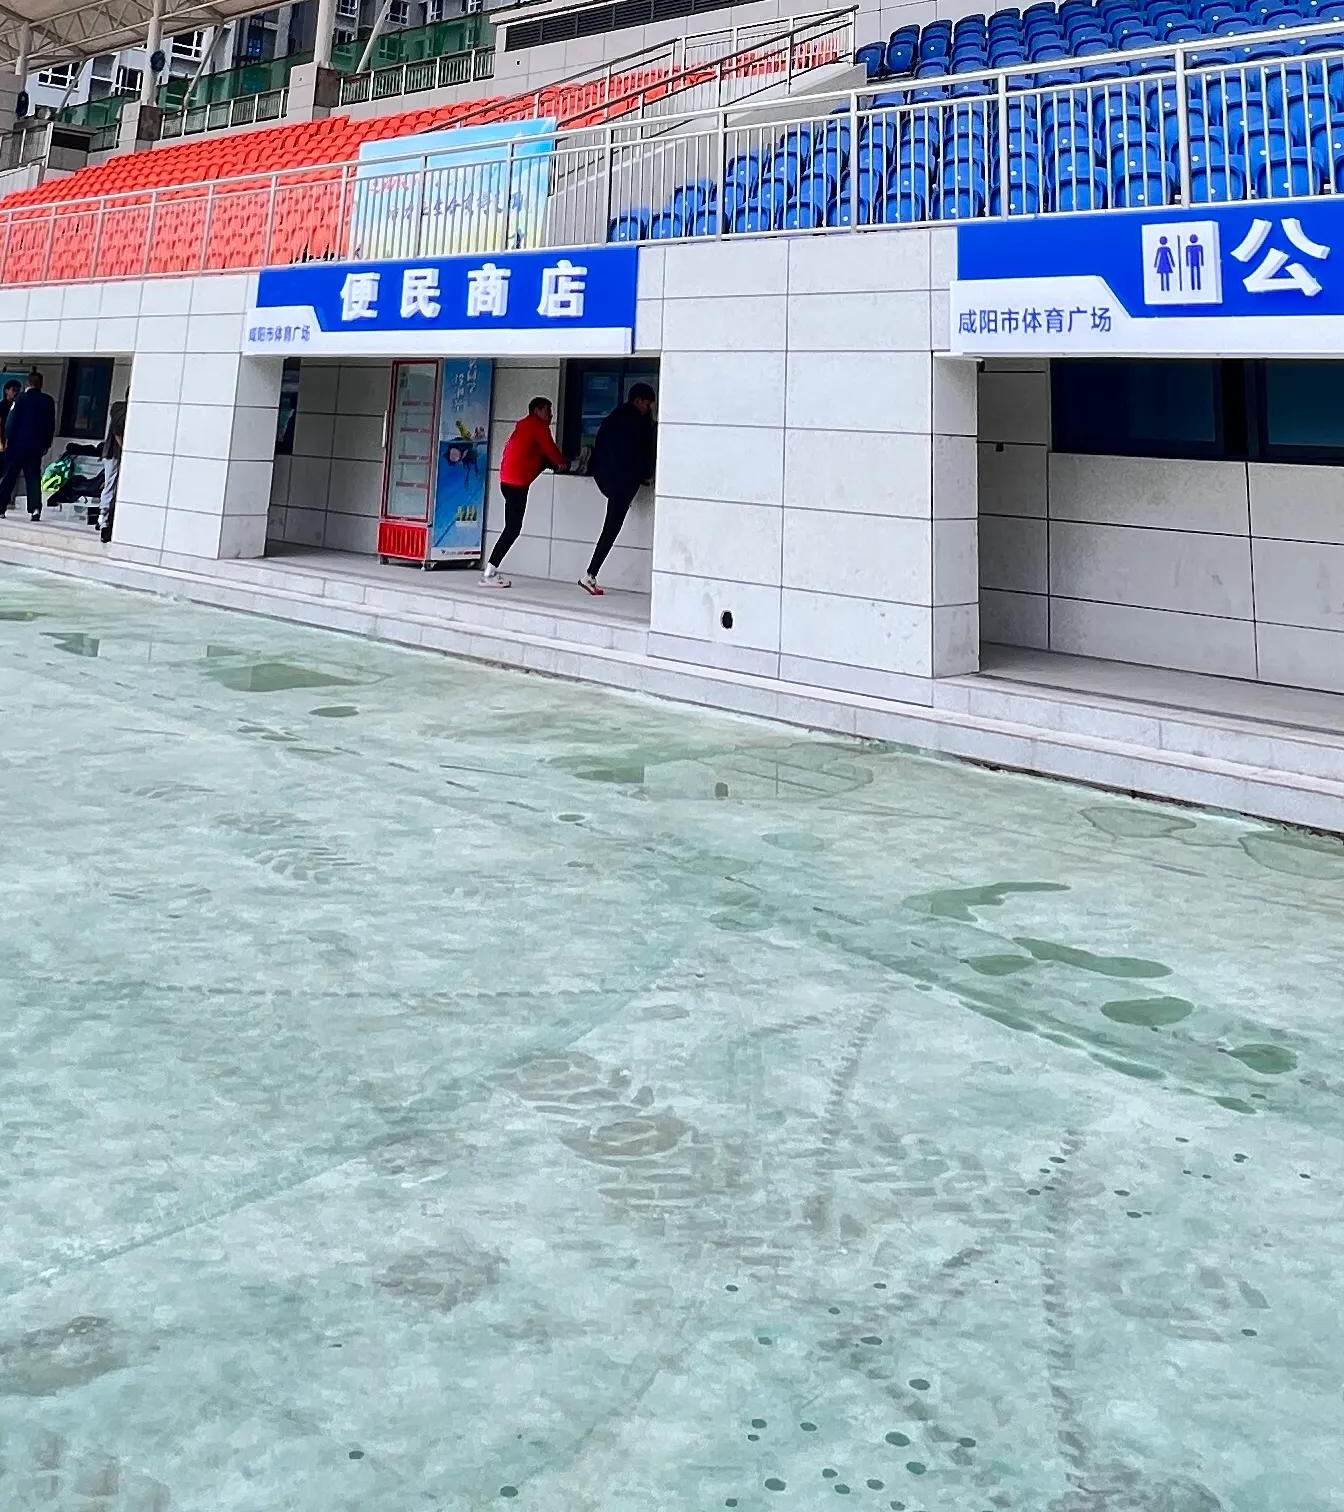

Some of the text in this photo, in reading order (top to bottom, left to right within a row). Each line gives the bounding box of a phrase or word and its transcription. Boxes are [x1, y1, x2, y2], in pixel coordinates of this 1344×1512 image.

[340, 260, 588, 321] 便民商店
[958, 306, 1112, 334] 咸阳市体育广场
